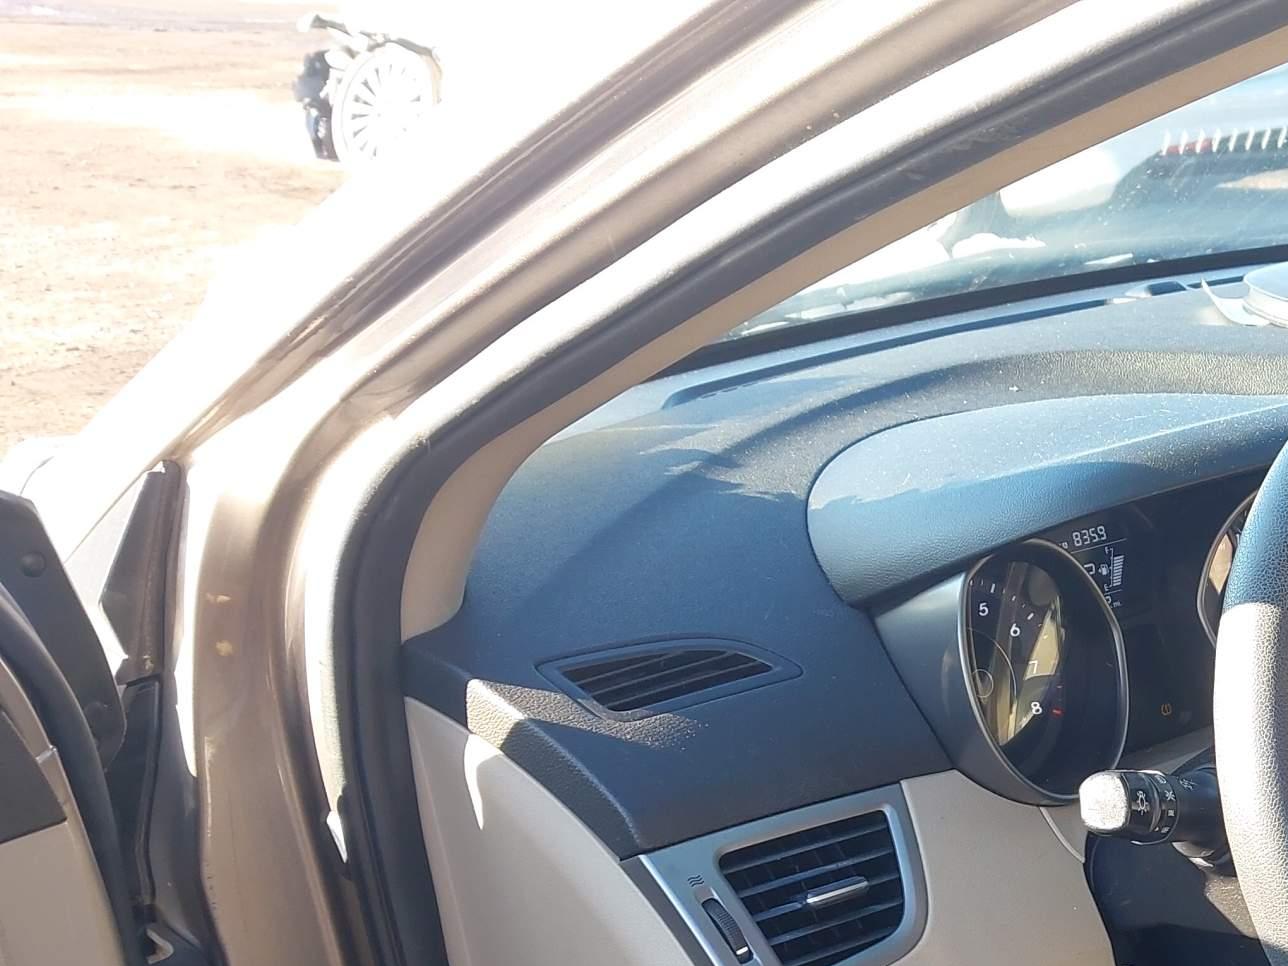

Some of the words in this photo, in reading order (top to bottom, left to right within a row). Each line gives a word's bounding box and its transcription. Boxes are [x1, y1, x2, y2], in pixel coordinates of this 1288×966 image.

[978, 602, 989, 617] 5
[1009, 623, 1021, 637] 6
[1027, 660, 1038, 675] 7
[1030, 701, 1043, 715] 8
